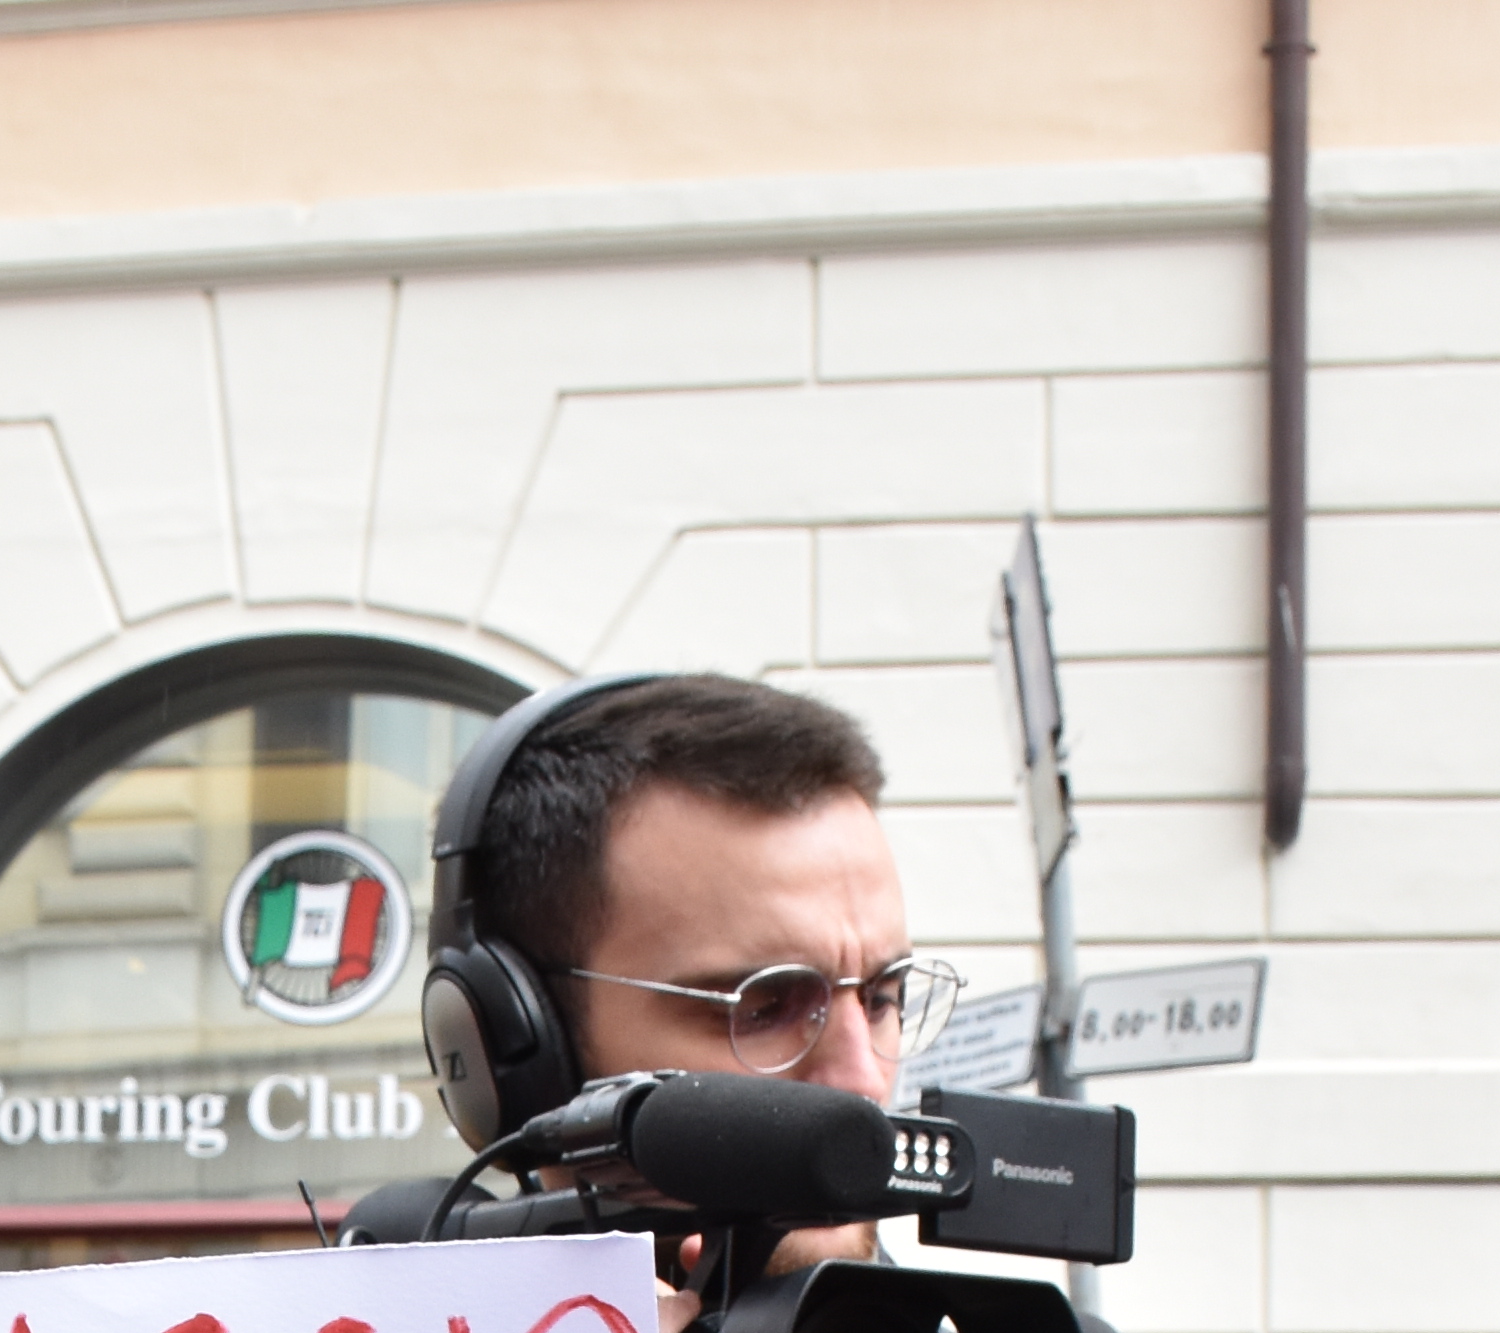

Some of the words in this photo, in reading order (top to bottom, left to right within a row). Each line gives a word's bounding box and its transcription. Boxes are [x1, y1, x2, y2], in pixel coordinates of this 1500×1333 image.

[247, 1073, 424, 1142] Club
[887, 1174, 943, 1194] Panasonic
[992, 1157, 1075, 1186] Panasonic
